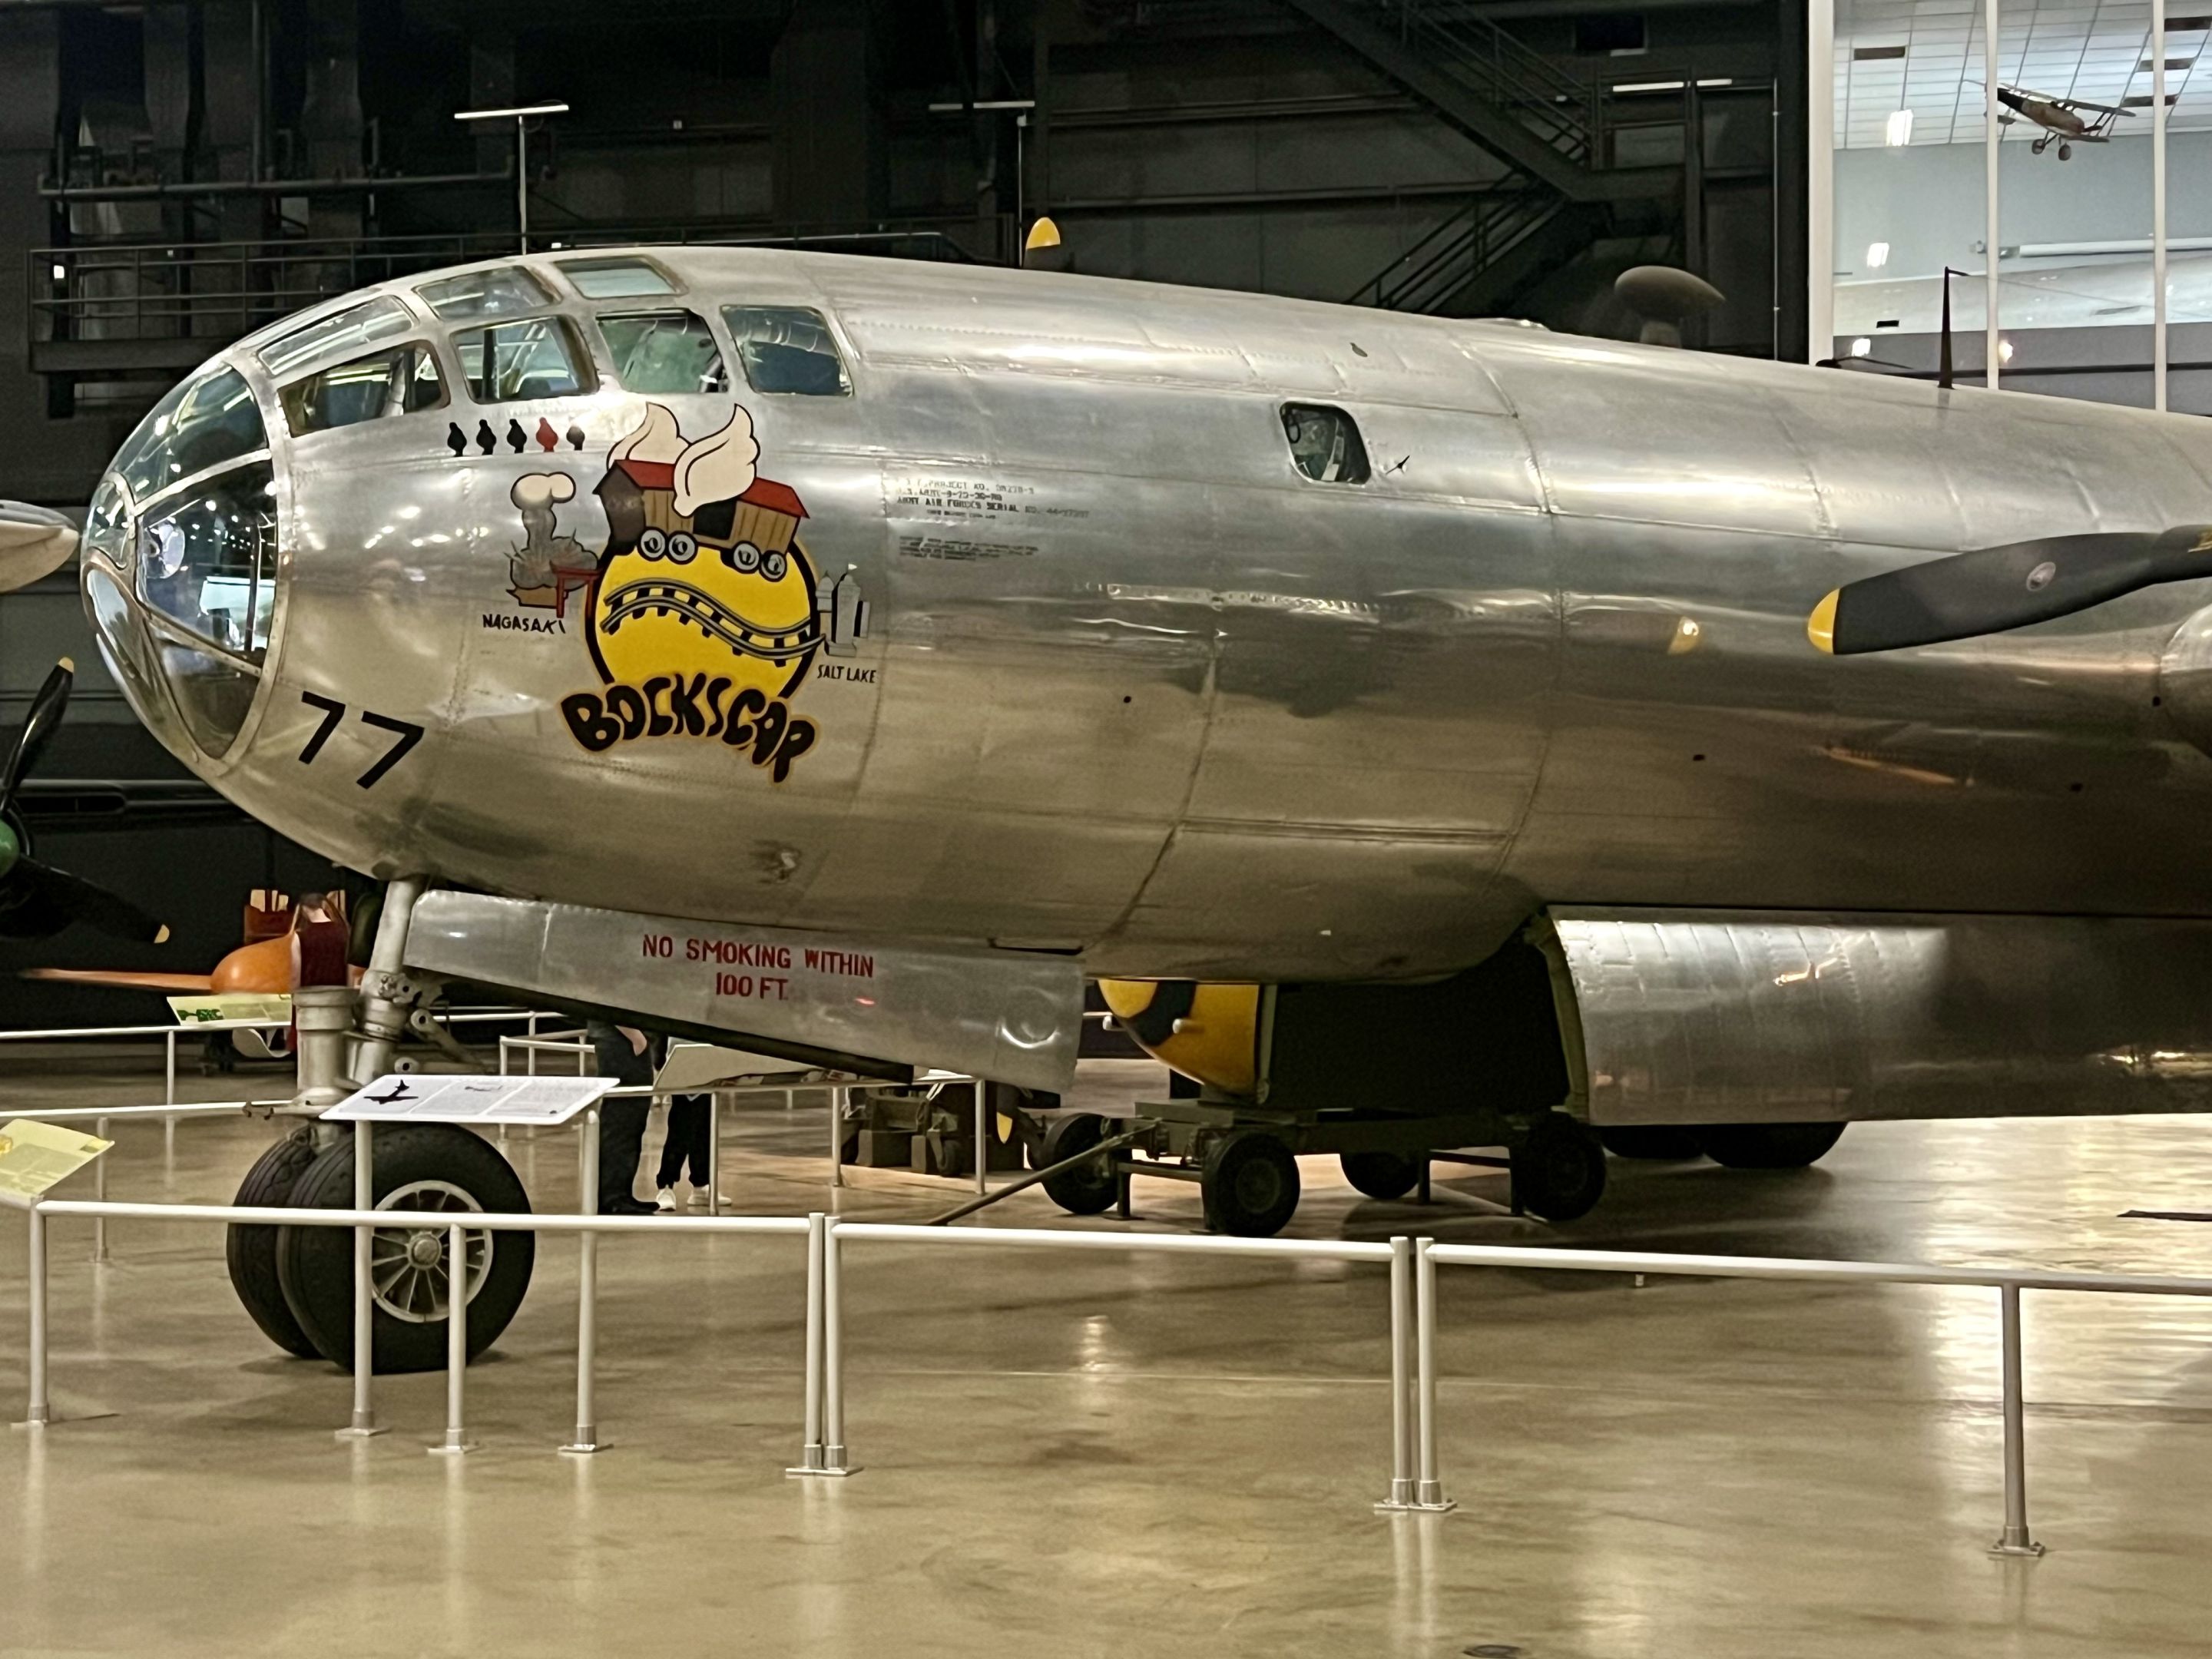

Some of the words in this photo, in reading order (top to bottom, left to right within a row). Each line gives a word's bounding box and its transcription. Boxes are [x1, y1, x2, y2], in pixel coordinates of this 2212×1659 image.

[925, 498, 942, 507] AIR
[986, 502, 1020, 513] SERIAL
[482, 613, 566, 634] NAGASAKI
[816, 664, 845, 680] SALT
[846, 667, 876, 684] LAKE
[298, 690, 426, 790] 77
[561, 671, 816, 784] BOCKSCAR
[642, 933, 674, 958] NO
[686, 938, 792, 970] SMOKING
[804, 948, 875, 979] WITHIN
[715, 971, 753, 998] 100
